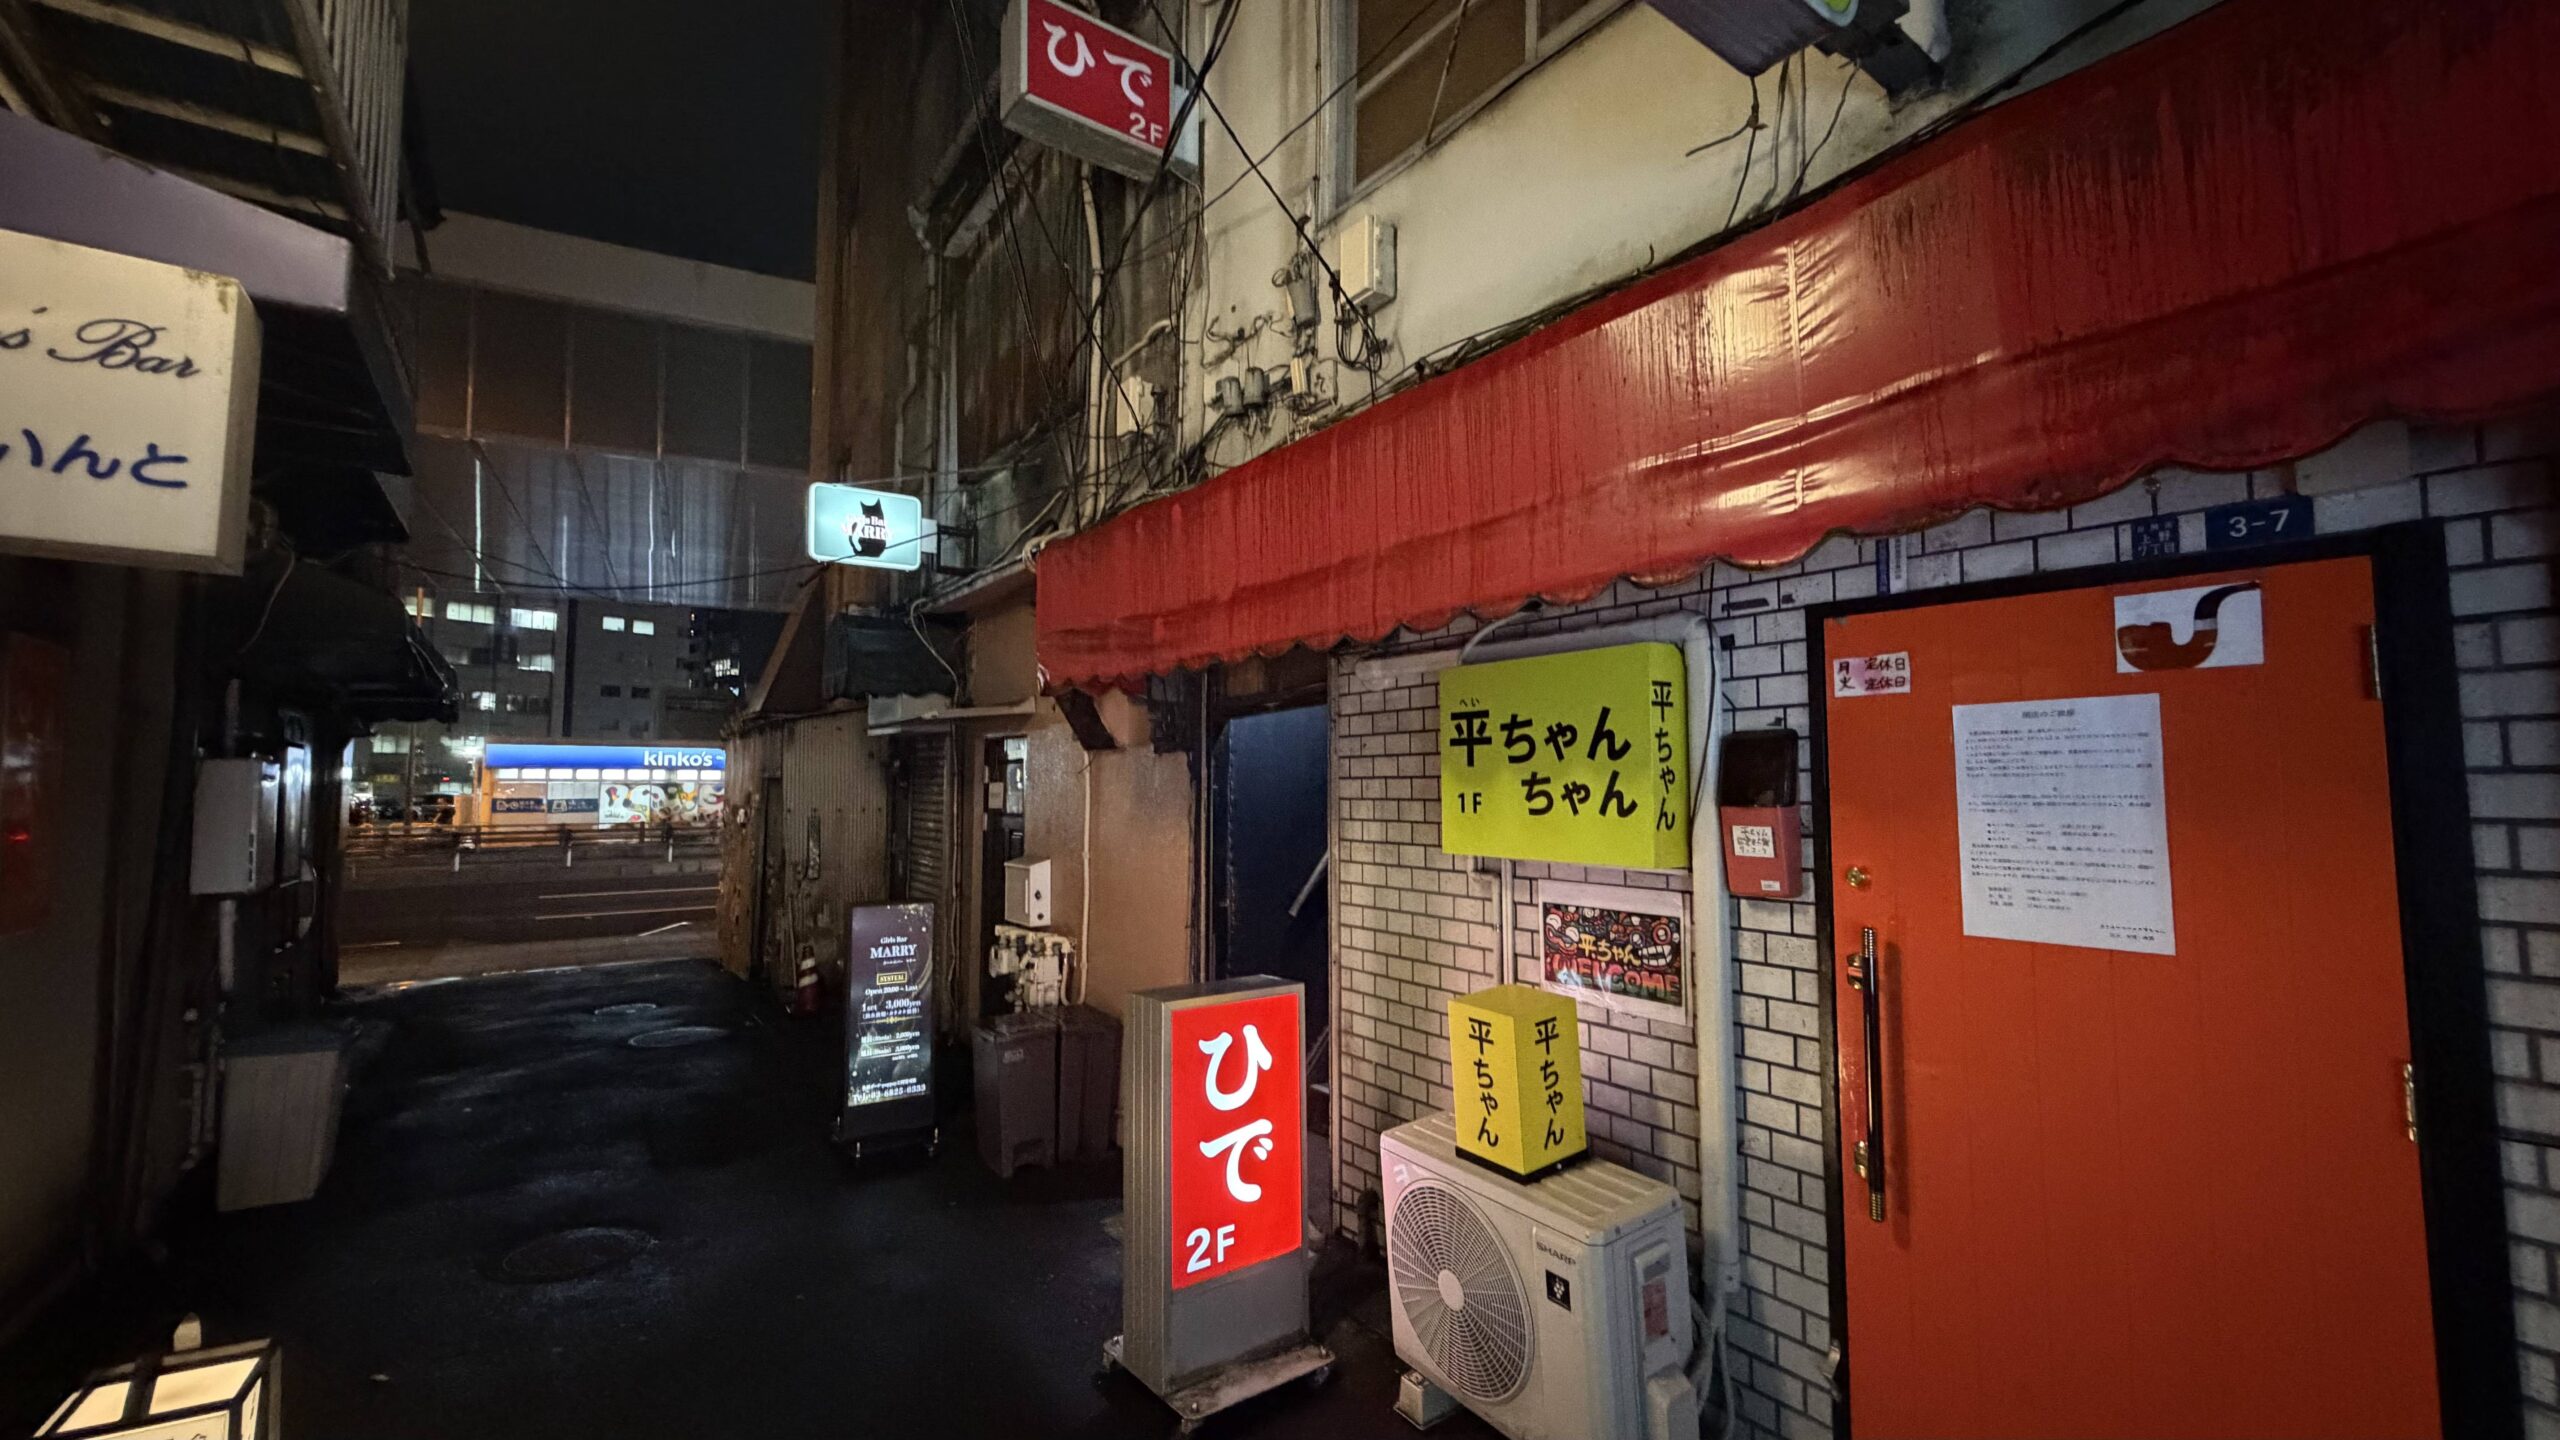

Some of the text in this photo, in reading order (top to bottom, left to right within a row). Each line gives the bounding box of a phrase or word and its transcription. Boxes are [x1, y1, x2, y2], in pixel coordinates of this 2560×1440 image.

[1042, 19, 1152, 107] ひで
[1129, 112, 1163, 143] 2F
[47, 319, 200, 378] Bar
[2228, 508, 2290, 538] 3-7
[1838, 657, 1906, 675] 月 定休日
[1864, 676, 1906, 691] 定休日
[1459, 696, 1480, 707] へい
[1450, 706, 1632, 768] 平ちゃん
[643, 750, 713, 767] kinko's
[1651, 680, 1676, 832] 平ちゃん
[1457, 792, 1482, 814] 1F
[1521, 769, 1639, 818] ちゃん
[870, 944, 917, 959] MARRY
[1578, 933, 1642, 967] 平ちゃん
[1552, 954, 1681, 996] WELCOME
[865, 988, 882, 997] Open
[1468, 1016, 1499, 1147] 平ちゃん
[1535, 1016, 1564, 1150] 平ちゃん
[1198, 1024, 1273, 1202] ひで
[1186, 1224, 1236, 1274] 2F
[1536, 1241, 1577, 1265] SHARP
